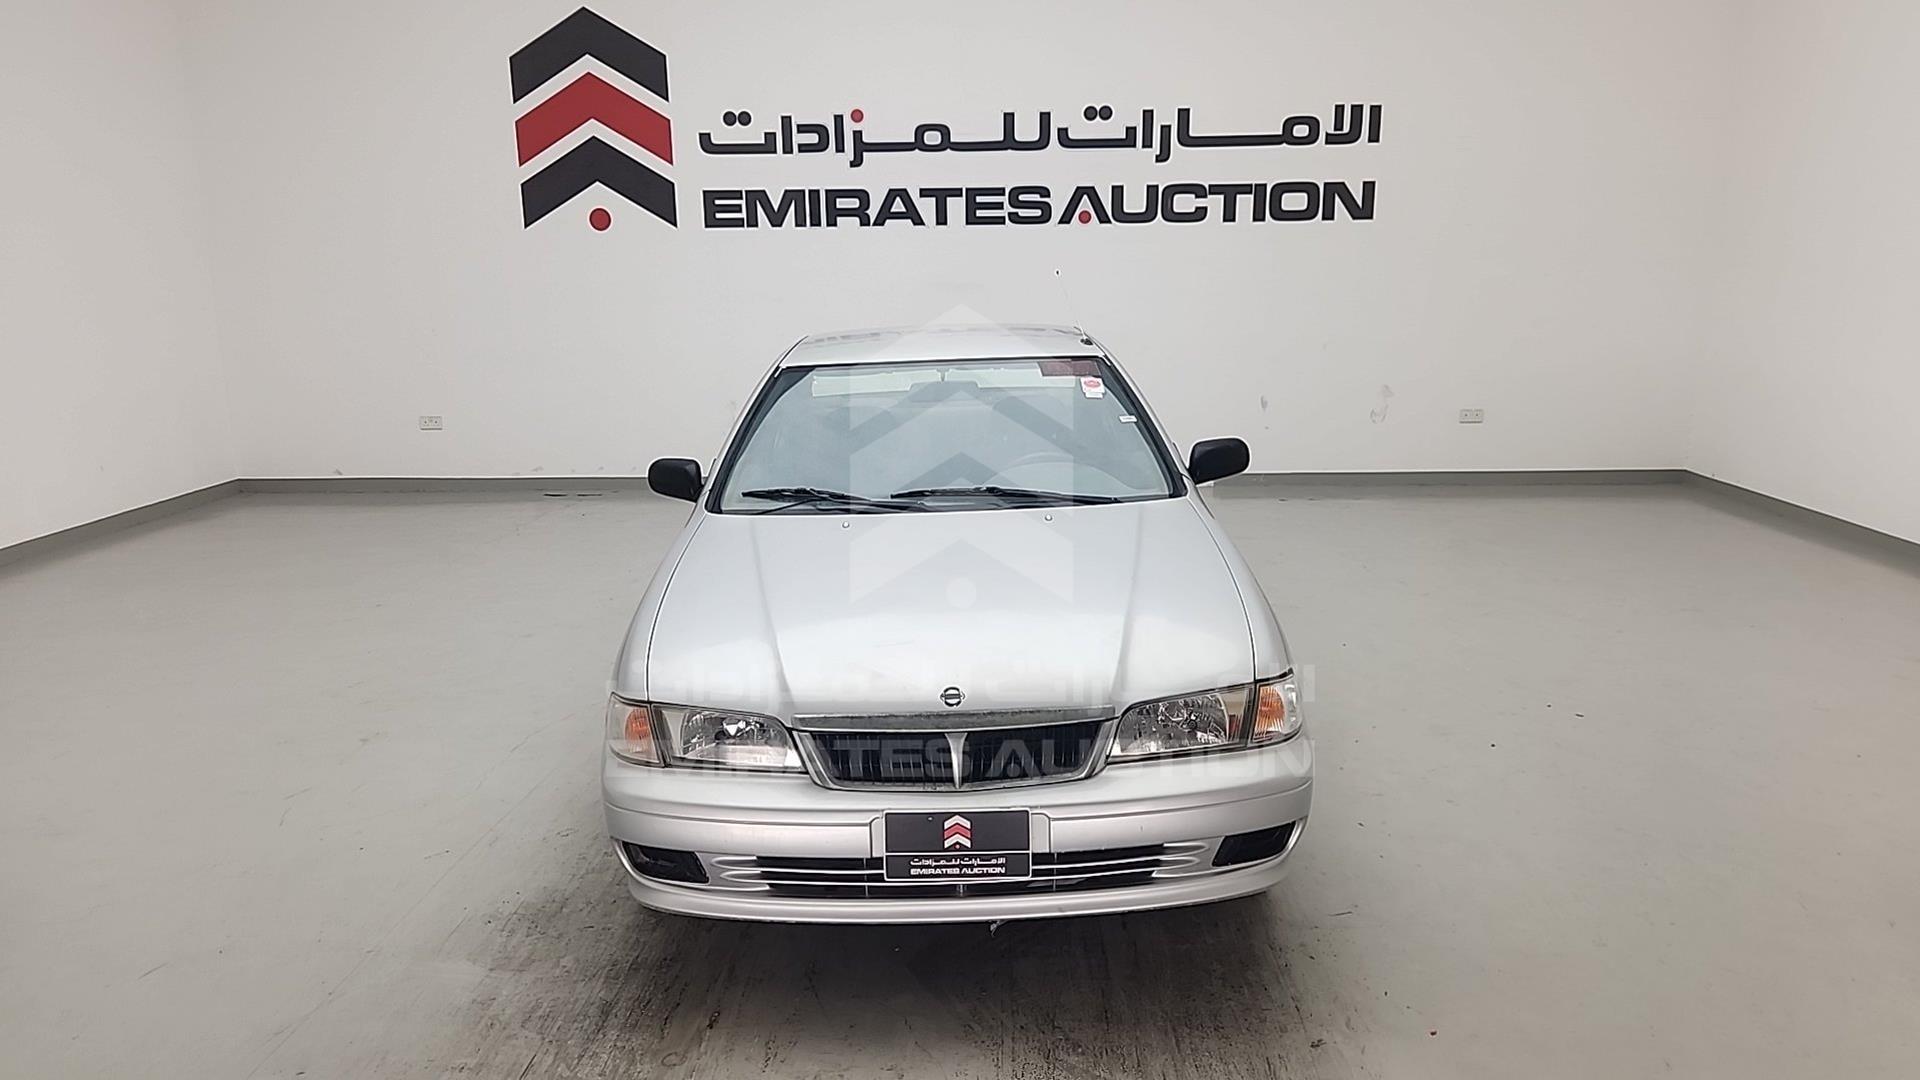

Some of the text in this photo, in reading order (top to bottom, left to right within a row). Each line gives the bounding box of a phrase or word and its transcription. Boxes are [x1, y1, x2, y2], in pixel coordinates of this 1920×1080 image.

[698, 103, 1384, 169] الامارات للمزادات
[702, 180, 1377, 229] EMIRATES AUCTION
[910, 866, 1006, 875] EMIRATES AUCTION
